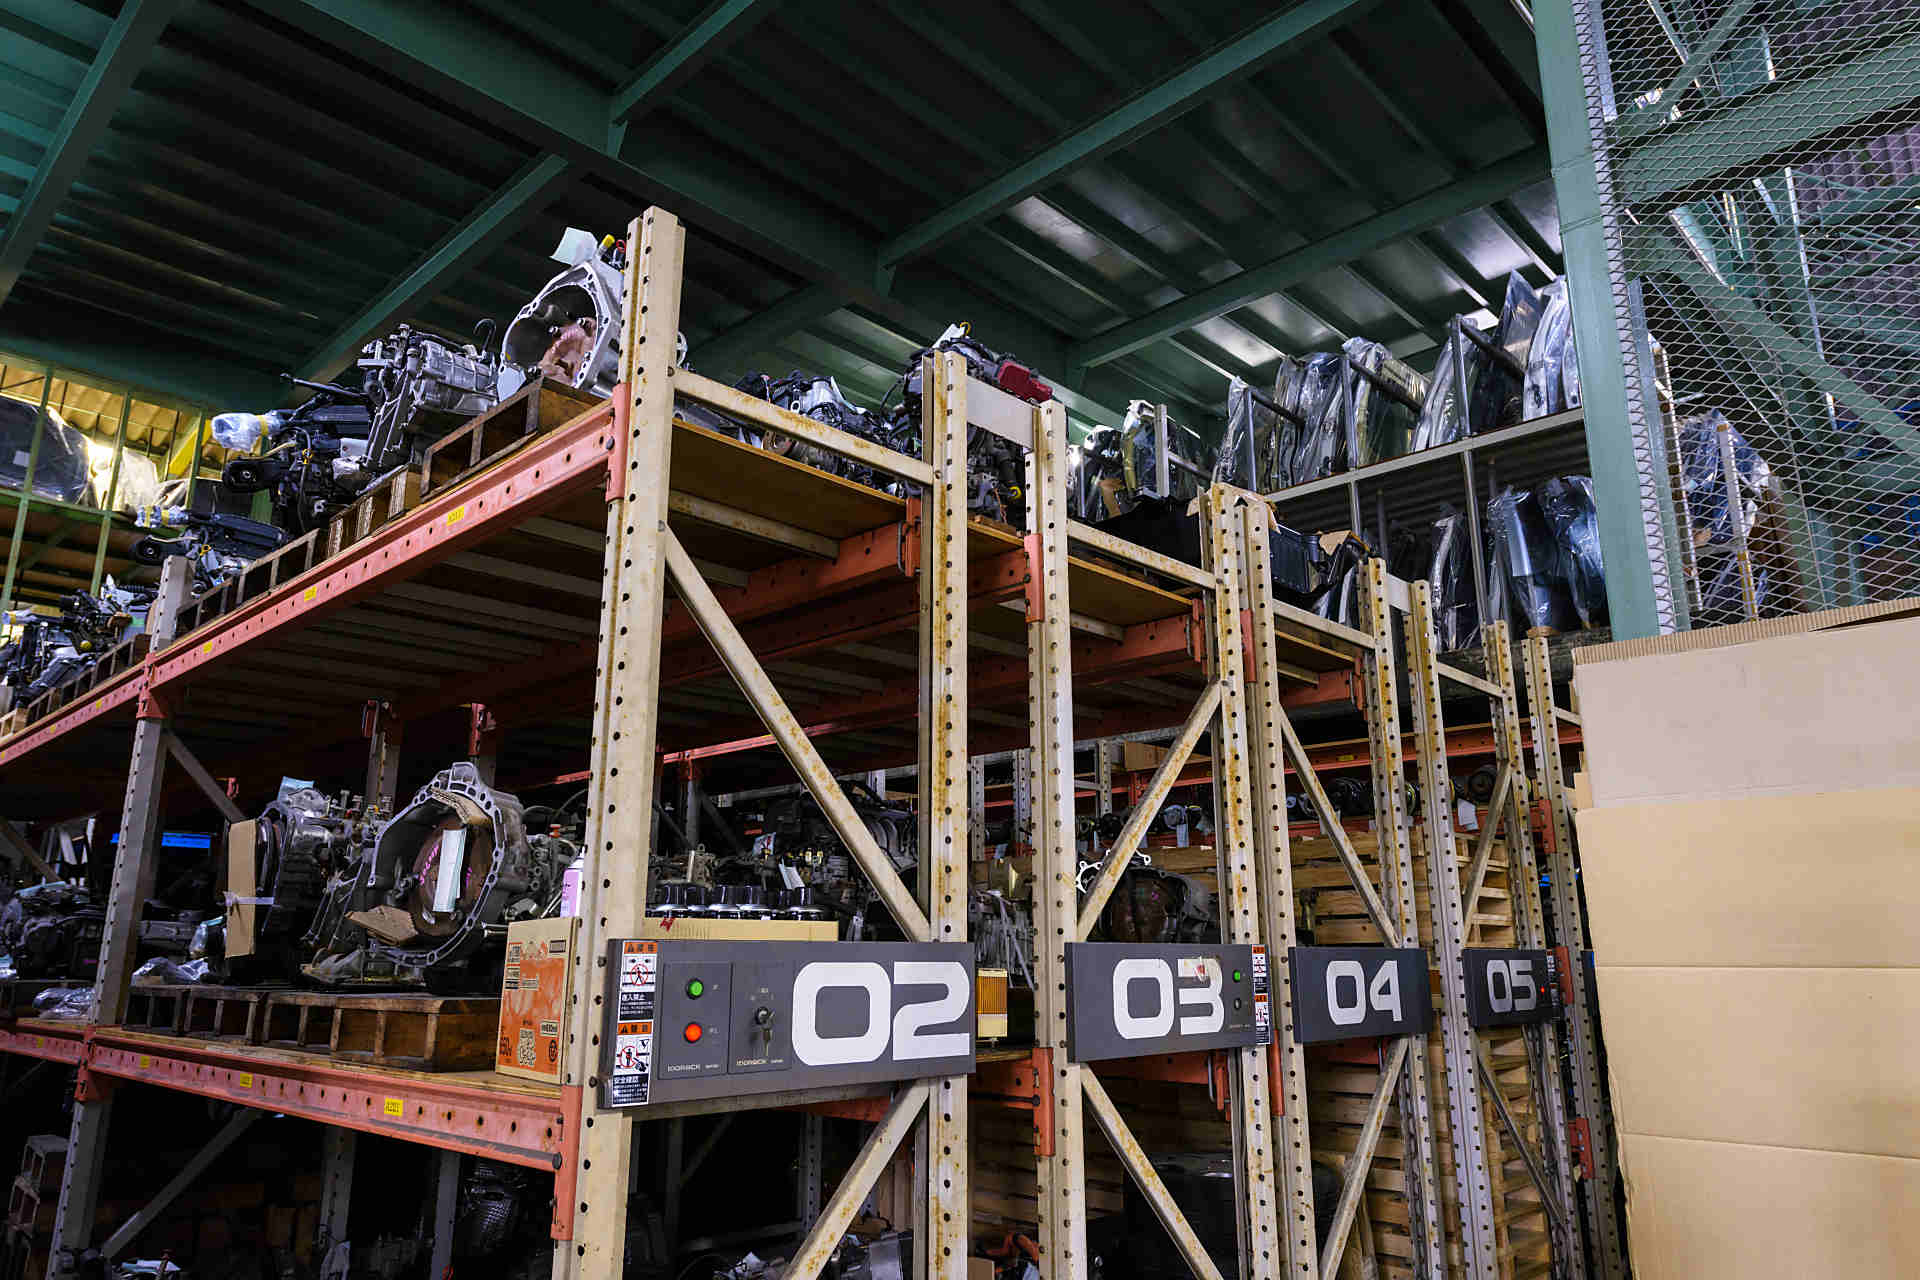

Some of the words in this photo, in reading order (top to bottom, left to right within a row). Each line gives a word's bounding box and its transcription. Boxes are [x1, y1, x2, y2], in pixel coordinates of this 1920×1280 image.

[792, 961, 970, 1066] 02
[1113, 958, 1224, 1040] 03
[1326, 960, 1402, 1025] 04
[1486, 959, 1537, 1013] 05
